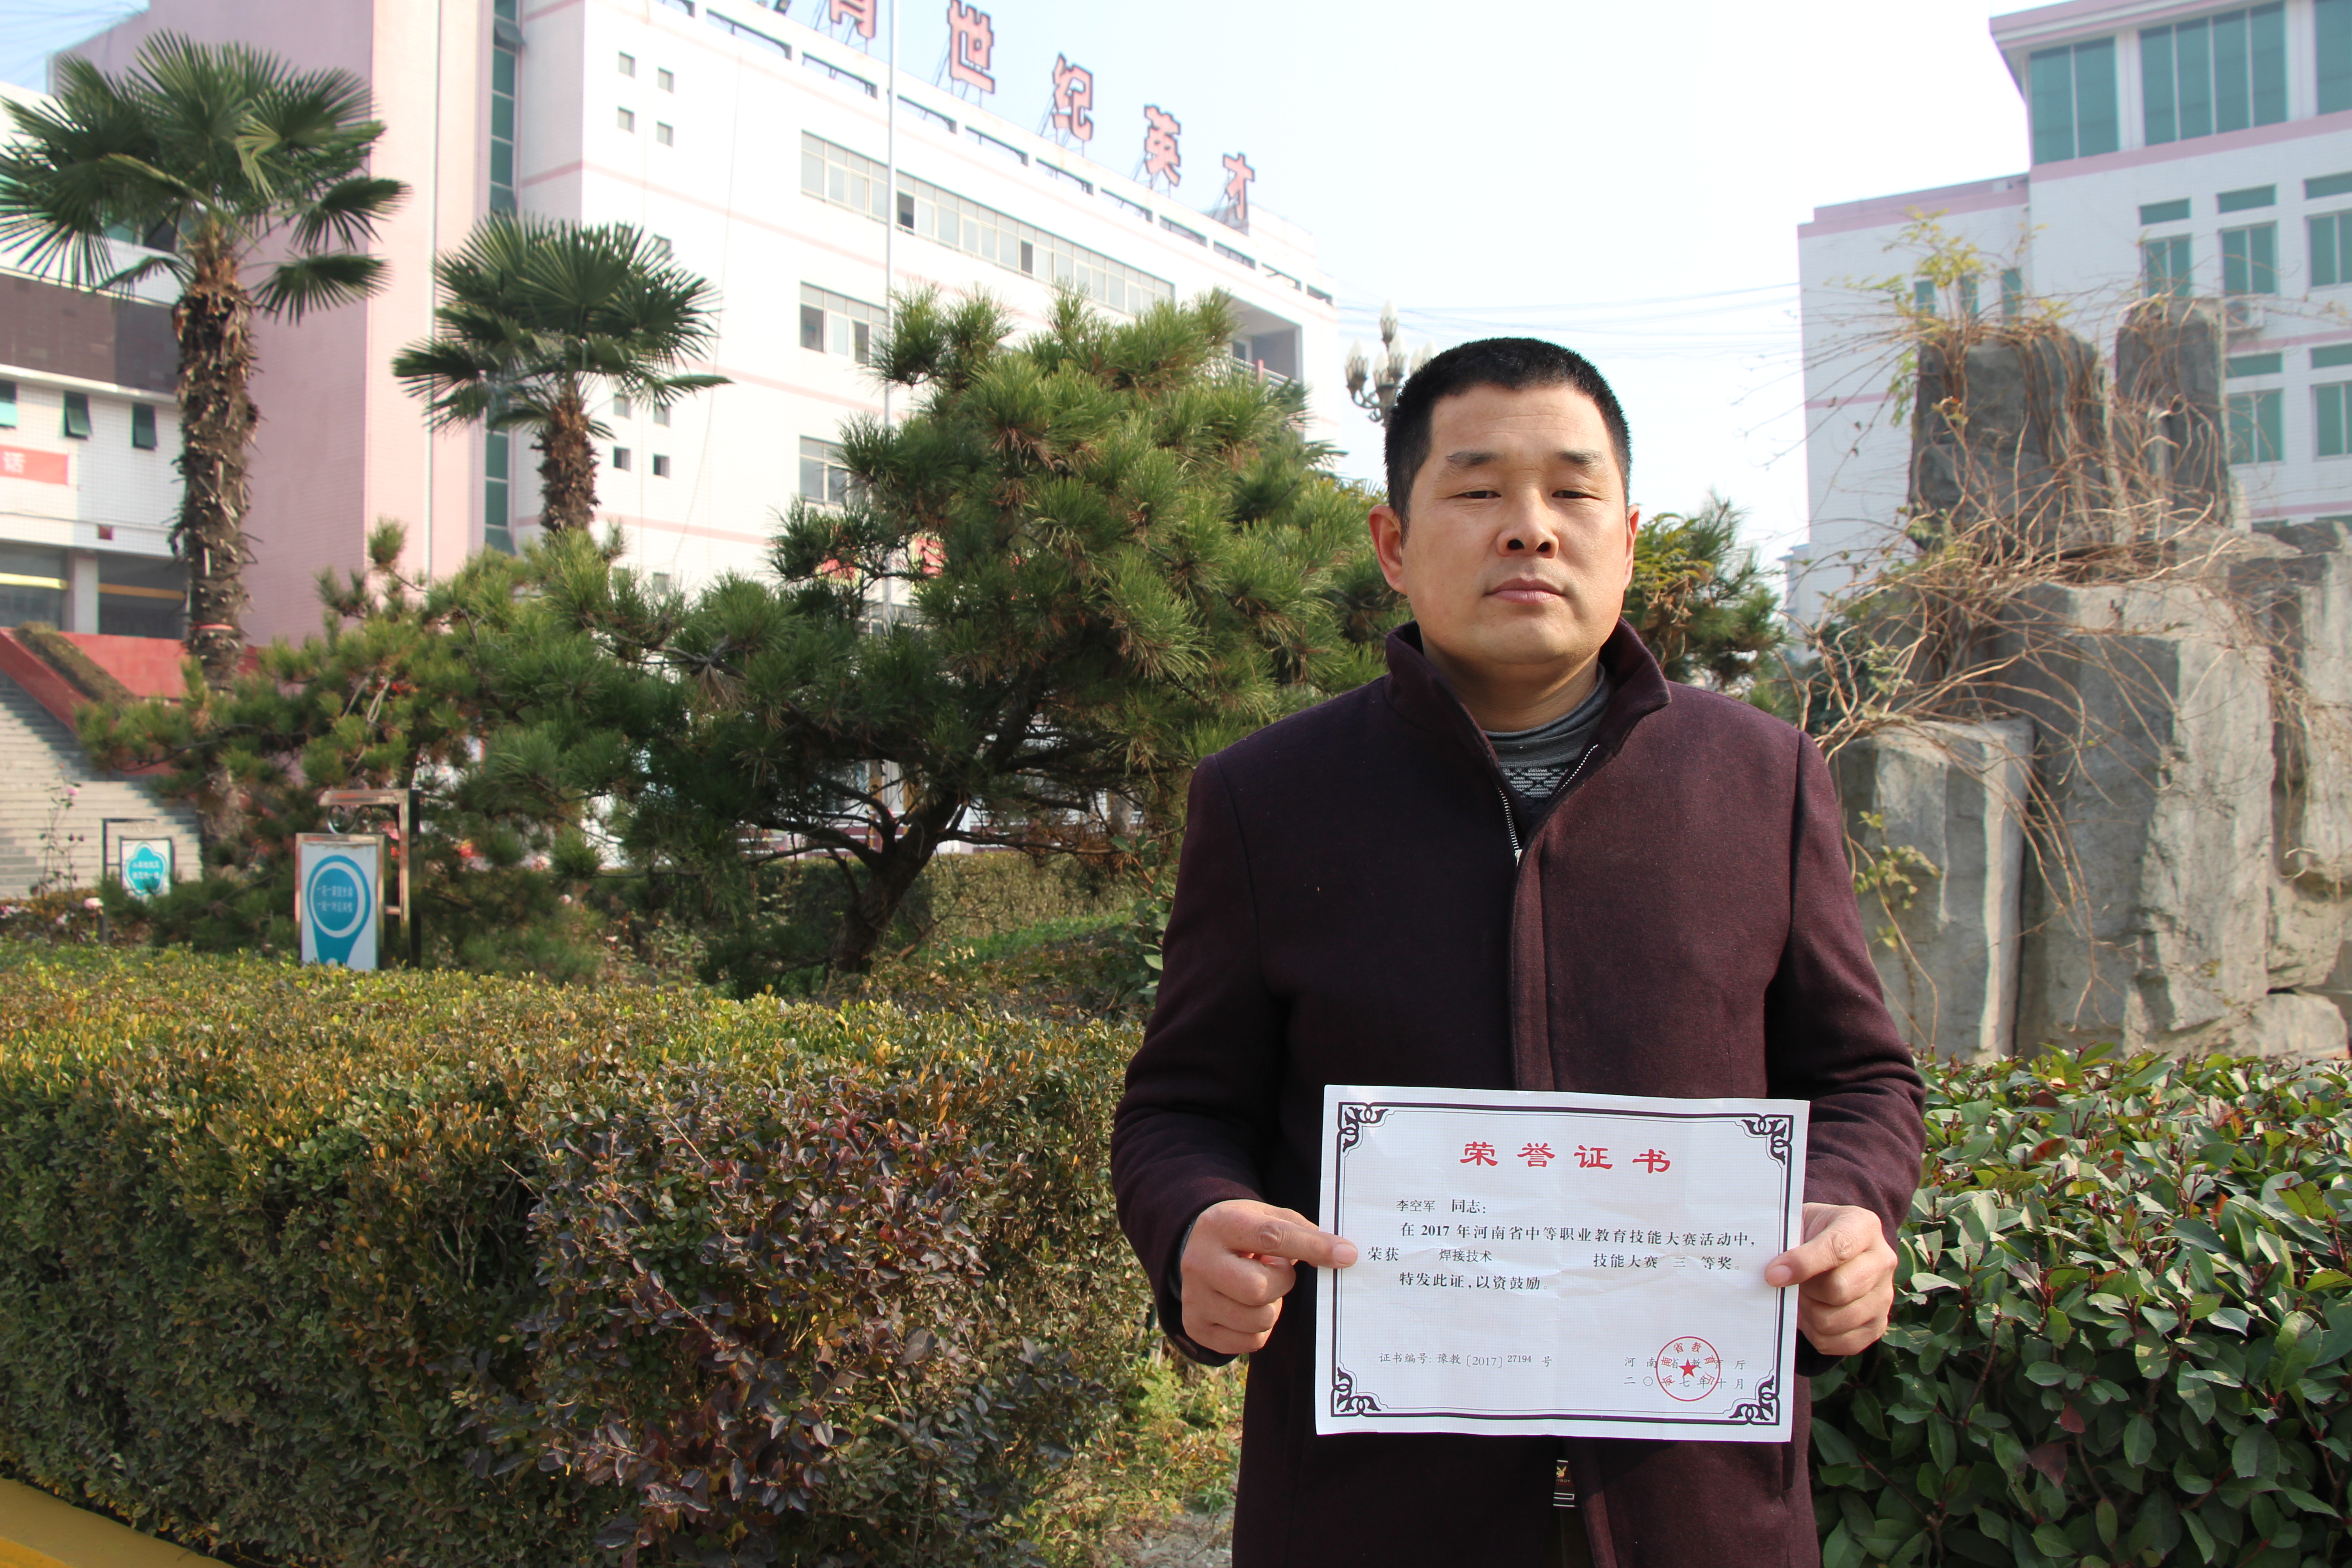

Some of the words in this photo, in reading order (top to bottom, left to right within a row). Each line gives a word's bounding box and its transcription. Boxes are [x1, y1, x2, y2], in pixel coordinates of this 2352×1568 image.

[1459, 1141, 1671, 1174] 荣誉证书
[1396, 1199, 1436, 1212] 李空军
[1367, 1246, 1400, 1261] 荣获
[1439, 1249, 1493, 1262] 焊接技术
[1593, 1253, 1658, 1269] 技能大赛
[1673, 1256, 1686, 1268] 三
[1507, 1354, 1532, 1363] 27194
[1541, 1356, 1552, 1367] 号
